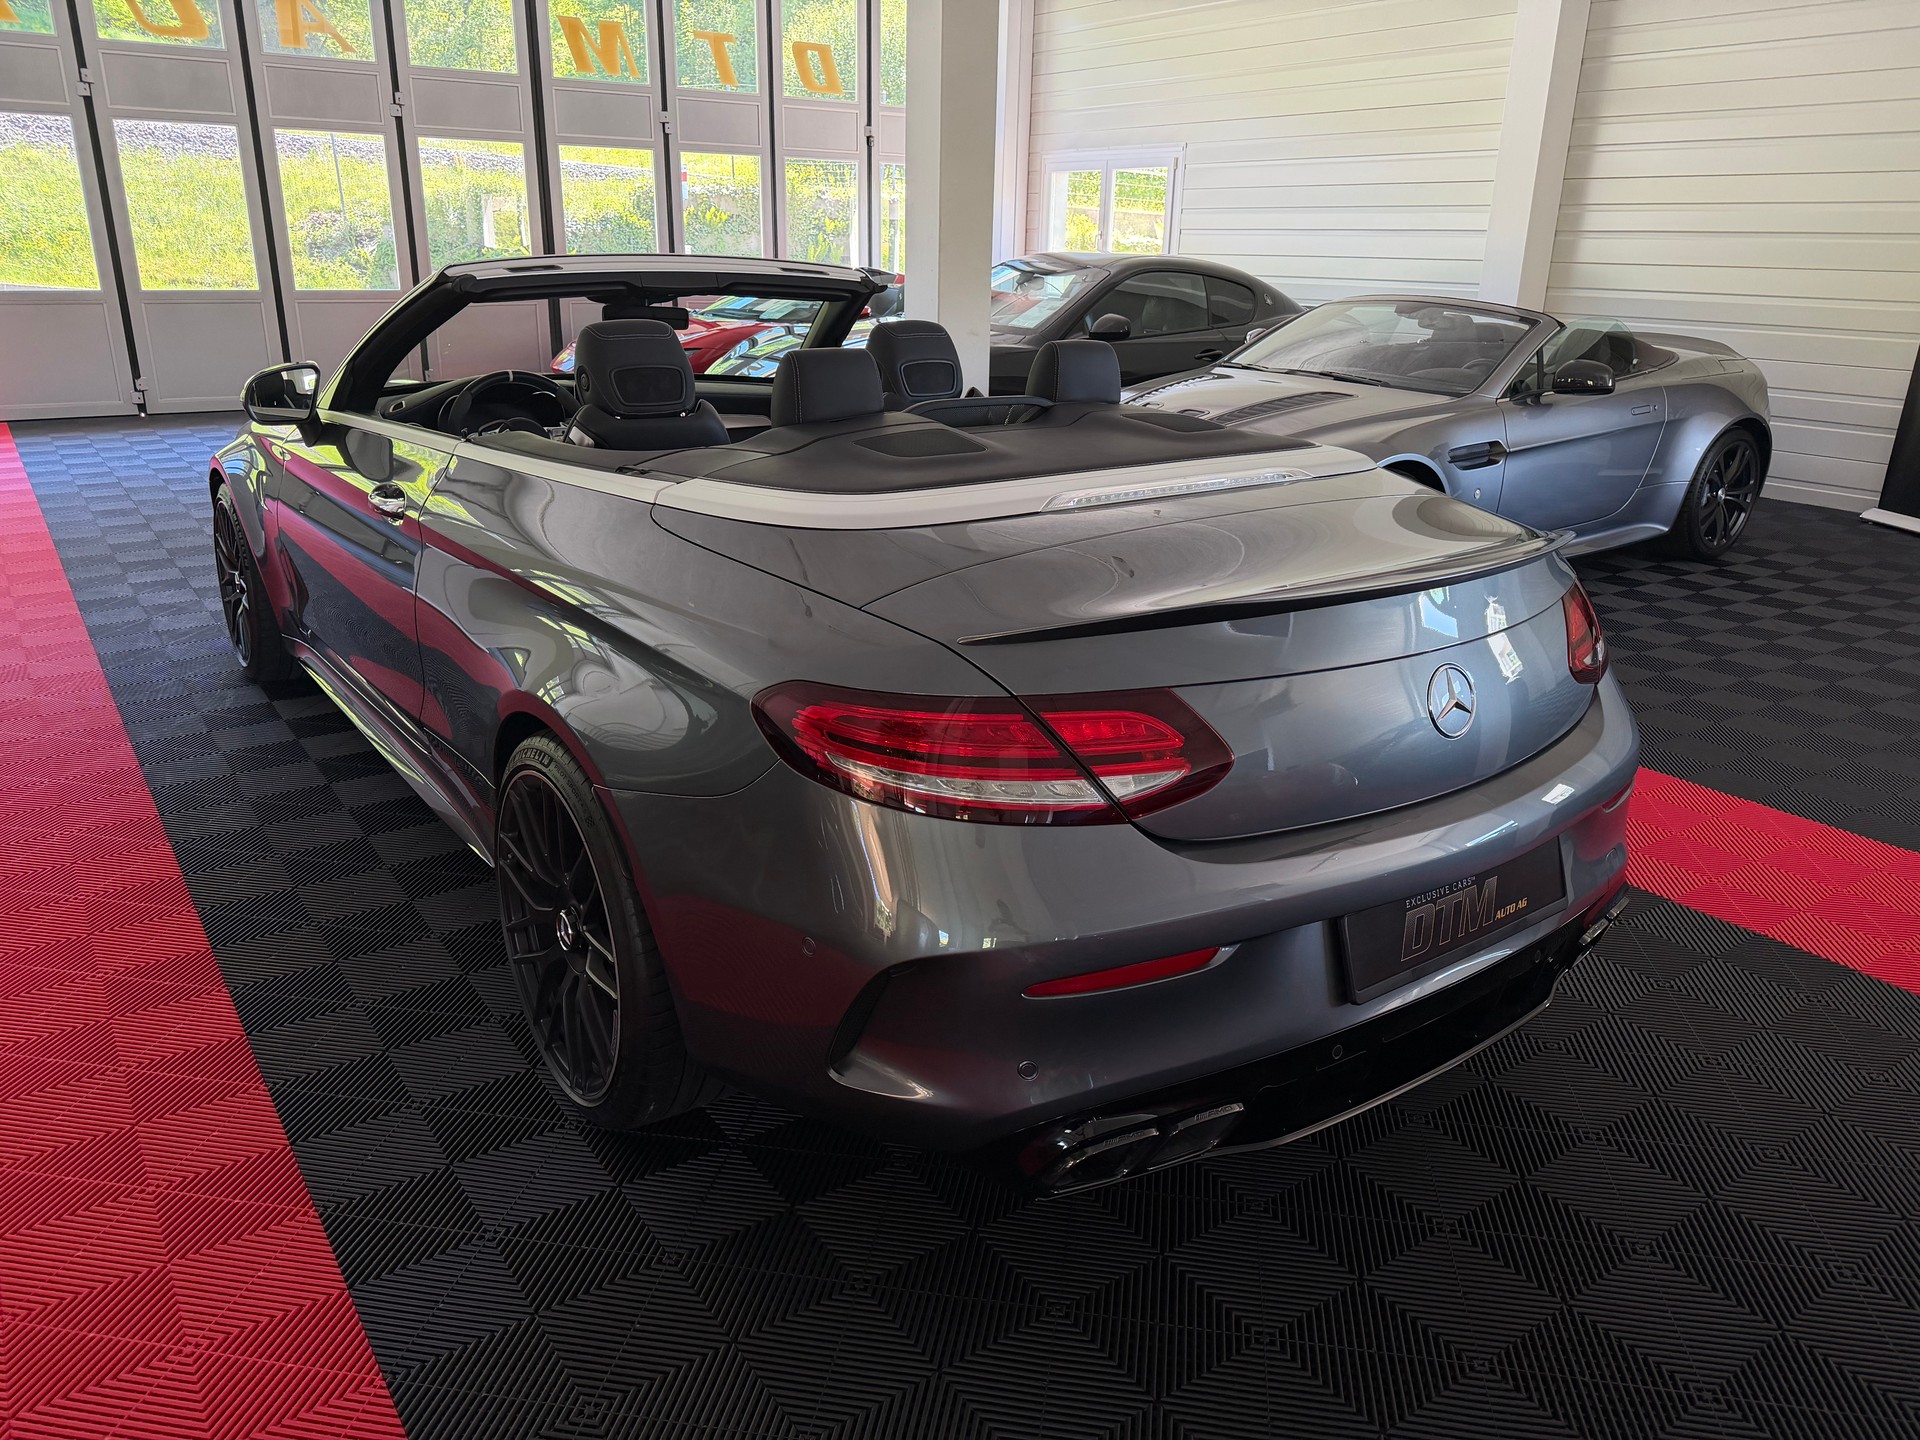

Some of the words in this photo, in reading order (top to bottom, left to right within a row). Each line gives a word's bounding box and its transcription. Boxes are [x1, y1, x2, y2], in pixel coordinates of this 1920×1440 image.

[1405, 884, 1450, 909] EXCLUSIVE
[1494, 902, 1516, 921] AUTO
[1516, 897, 1528, 911] AG
[1400, 875, 1499, 962] DTM
